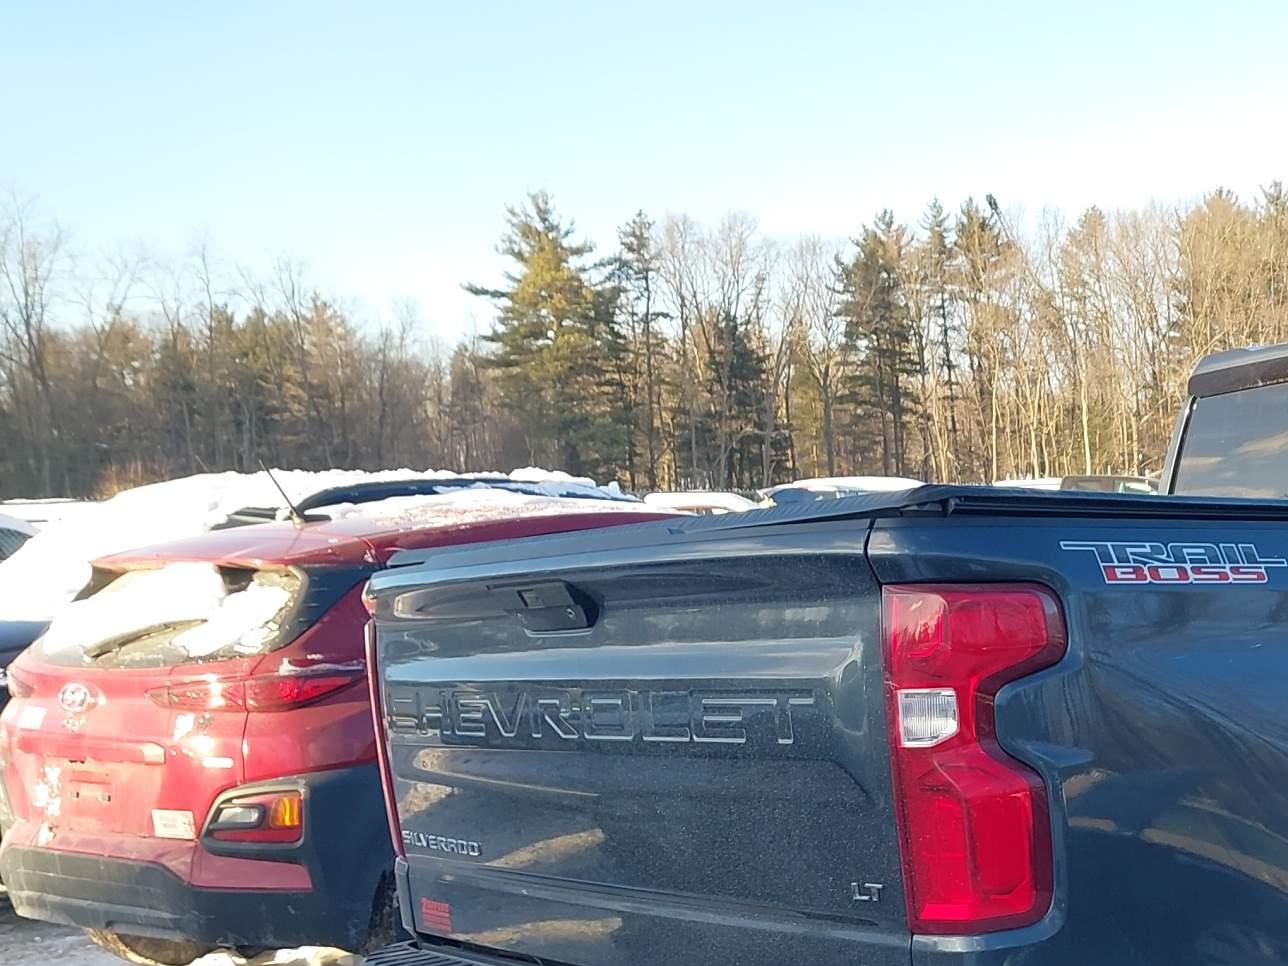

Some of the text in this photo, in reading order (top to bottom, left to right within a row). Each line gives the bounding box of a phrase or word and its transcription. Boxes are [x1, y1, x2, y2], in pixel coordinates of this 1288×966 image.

[1059, 541, 1288, 566] TRAIL
[1101, 564, 1269, 585] BOSS
[388, 688, 815, 745] CHEVROLET
[402, 830, 481, 857] SILVERADO
[850, 882, 886, 902] LT
